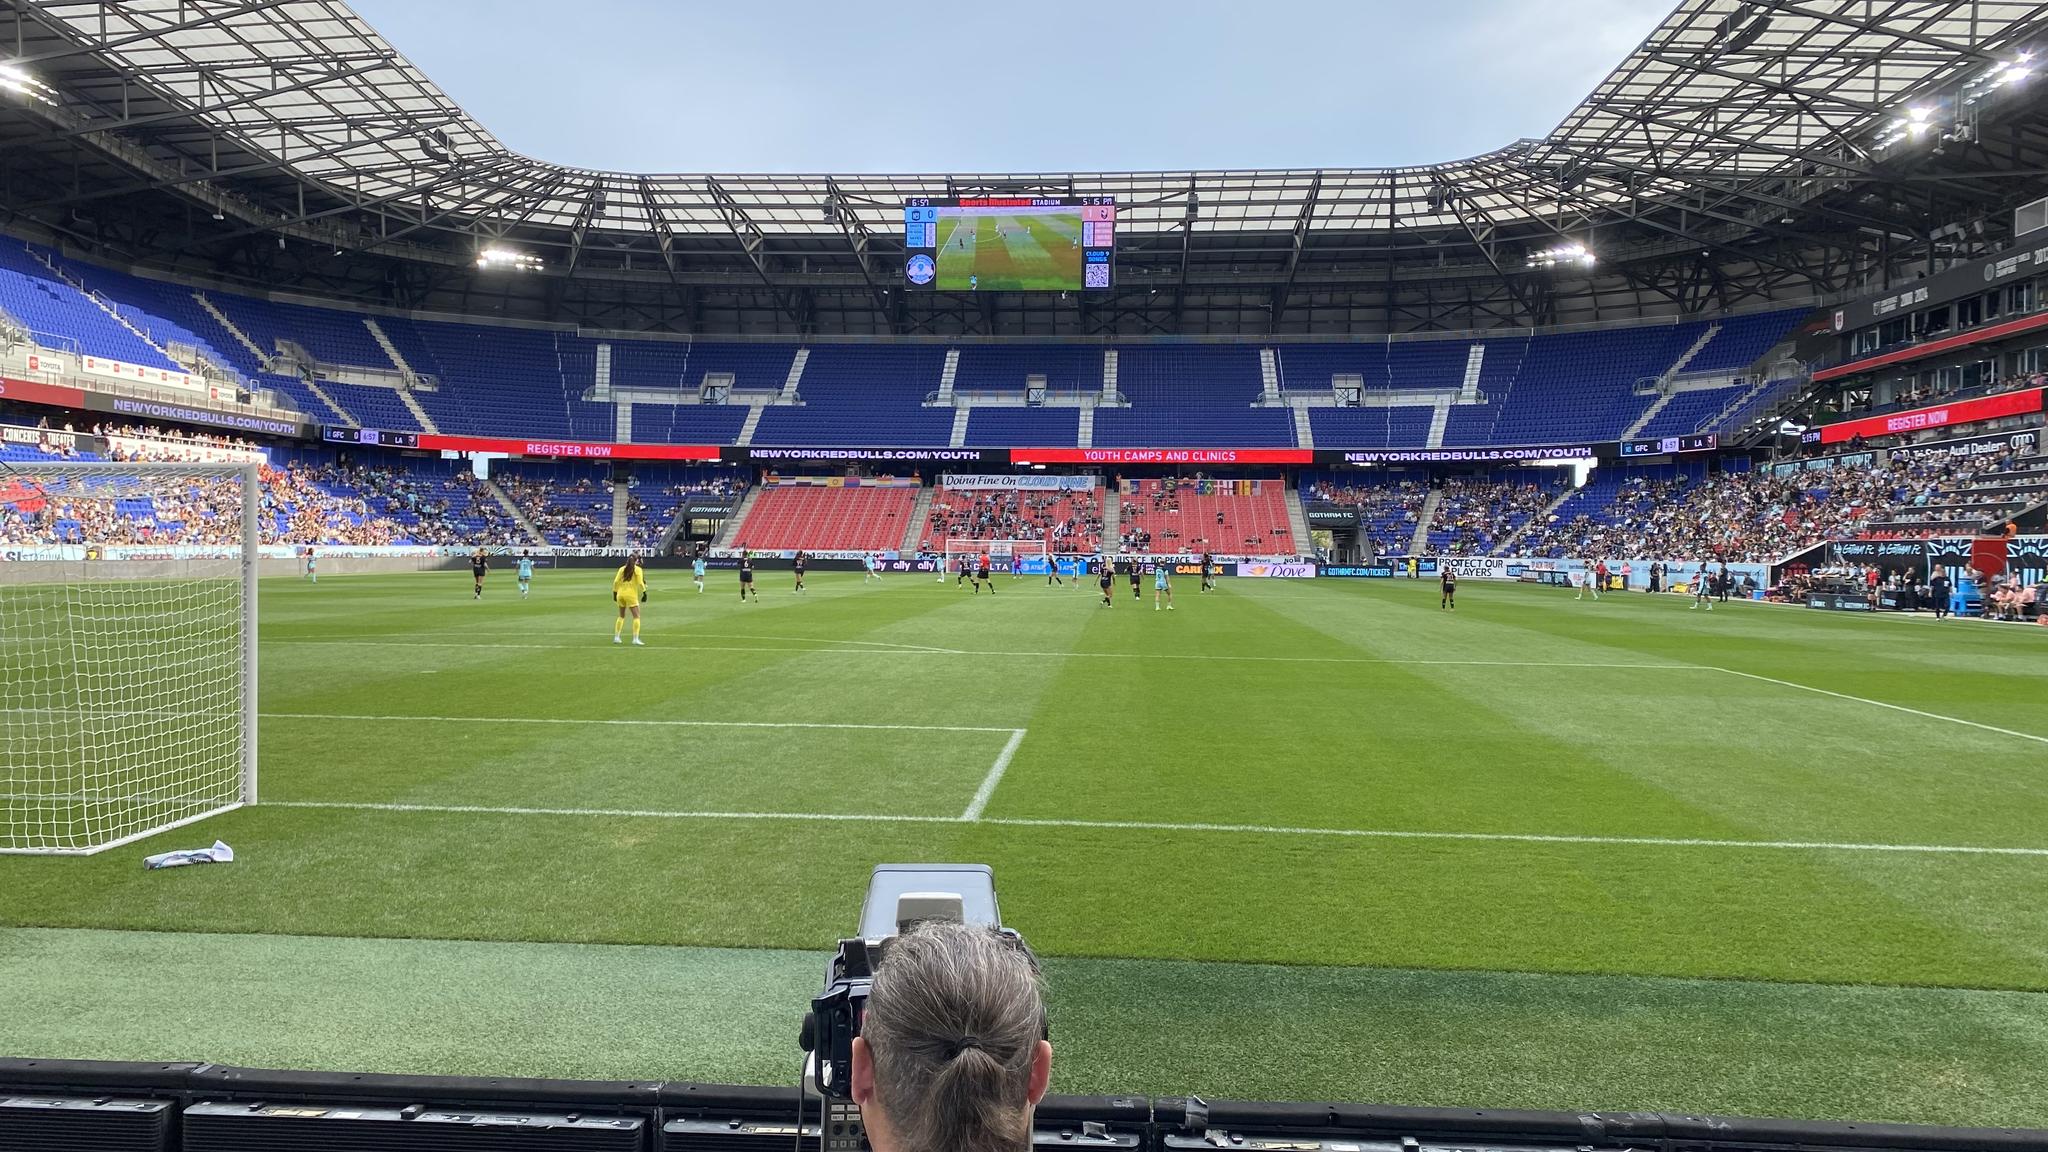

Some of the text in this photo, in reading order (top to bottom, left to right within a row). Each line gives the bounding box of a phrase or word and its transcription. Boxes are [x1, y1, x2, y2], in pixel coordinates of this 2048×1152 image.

[40, 361, 61, 369] TOYOTA
[114, 400, 295, 434] NEWYORKREDBULLS.COM/YOUTH
[1888, 410, 1948, 431] REGISTER NOW
[4, 428, 41, 443] CONCERTS
[527, 444, 611, 456] REGISTER NOW
[750, 450, 980, 460] NEWYORKREDBULLS.COM/YOUTH
[1345, 448, 1591, 461] NEWYORKREDBULLS.COM/YOUTH
[1950, 444, 1969, 456] Audi
[1084, 451, 1236, 461] YOUTH CAMPS AND CLINICS
[946, 475, 1089, 487] Doing Fine On CLOUD NINE
[893, 561, 911, 571] ally
[917, 561, 935, 571] ally
[973, 563, 1009, 571] DLTA
[1439, 559, 1503, 568] PROTECT OUR
[1175, 565, 1223, 574] CARX
[1271, 565, 1306, 577] Dove
[1328, 567, 1390, 576] GOTHAMFC.COM/TICKETS
[1451, 567, 1492, 576] PLAYERS
